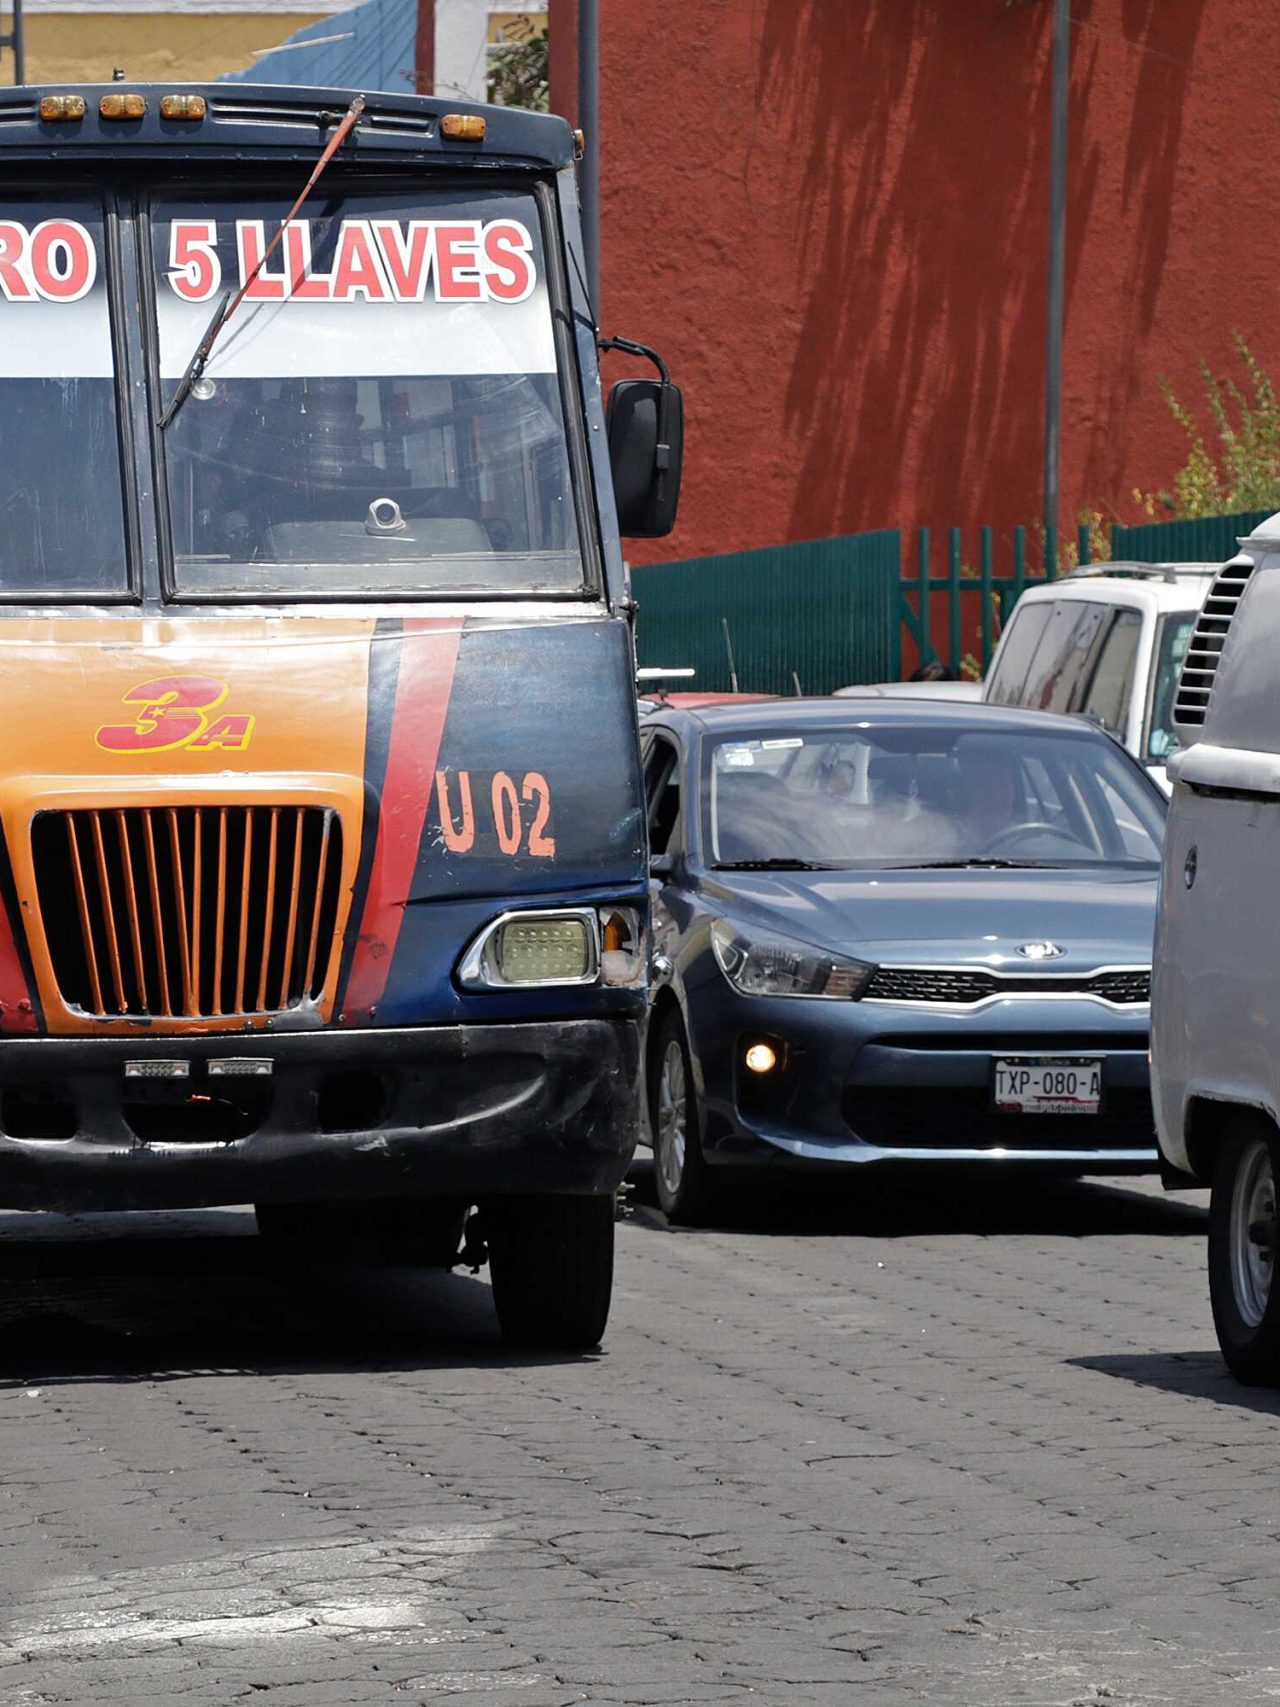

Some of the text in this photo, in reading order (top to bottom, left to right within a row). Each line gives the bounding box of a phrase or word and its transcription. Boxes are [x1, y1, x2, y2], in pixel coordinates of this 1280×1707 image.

[166, 219, 537, 304] 5 LLAVES
[435, 770, 556, 858] U 02
[996, 1070, 1101, 1096] TXP-080-A
